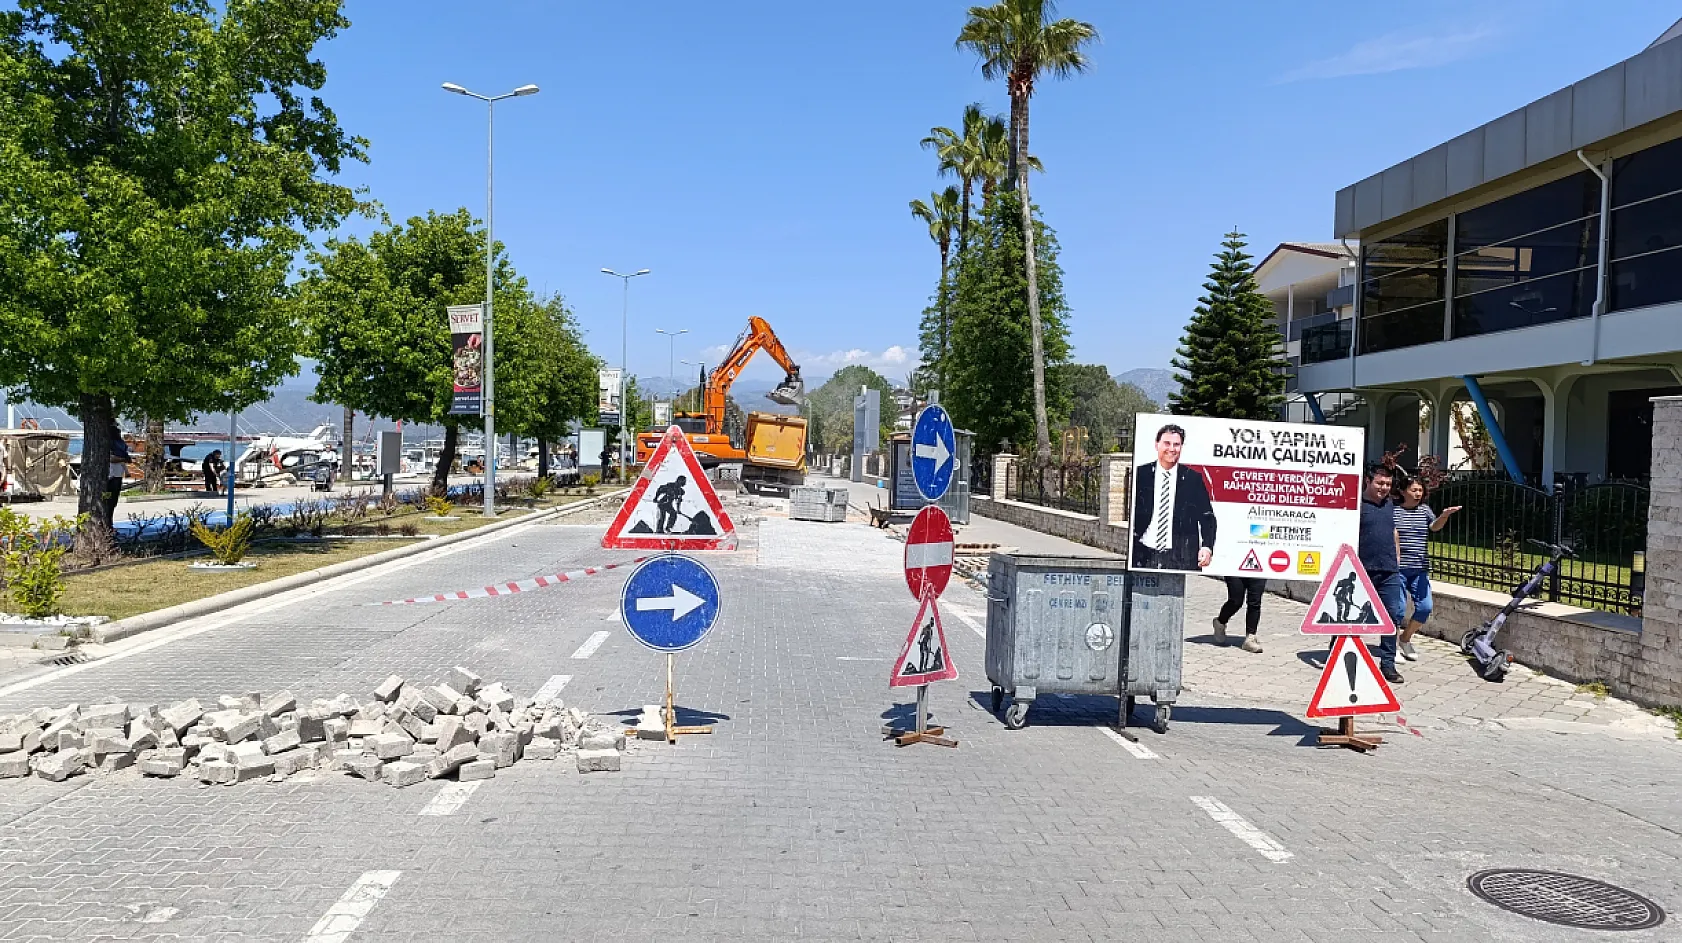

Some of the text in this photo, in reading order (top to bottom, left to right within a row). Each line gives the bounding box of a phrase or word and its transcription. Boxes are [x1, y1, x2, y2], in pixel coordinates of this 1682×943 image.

[450, 312, 479, 323] SERVET
[1229, 427, 1345, 449] YOL YAPIM VE
[1213, 444, 1355, 467] BAKIM ÇALIŞMASI
[1232, 470, 1335, 486] ÇEVREYE VERDİĞİMİZ
[1223, 481, 1343, 497] RAHATSIZLIKTAN DOLAYI
